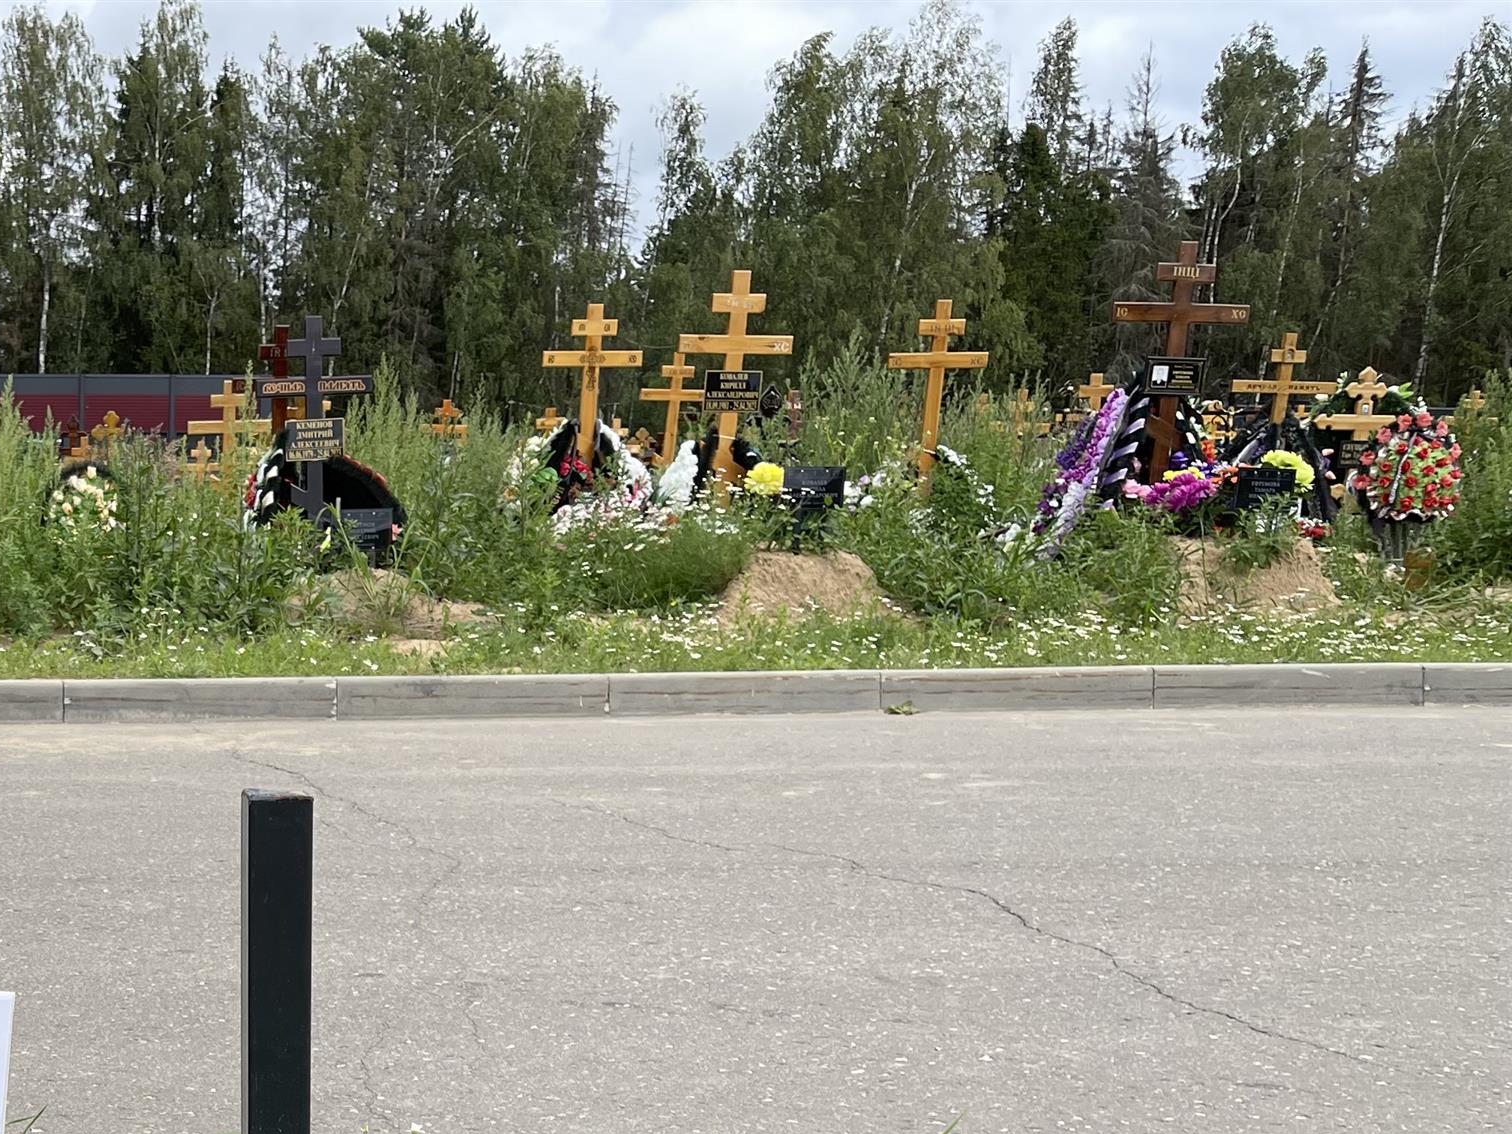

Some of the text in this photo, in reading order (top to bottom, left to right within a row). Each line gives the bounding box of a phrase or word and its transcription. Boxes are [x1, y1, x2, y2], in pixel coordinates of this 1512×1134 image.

[296, 421, 333, 429] КЕМЕНОВ
[296, 429, 333, 440] ДМИТРИЙ
[291, 440, 339, 449] АЛЕКСЕЕВИЧ
